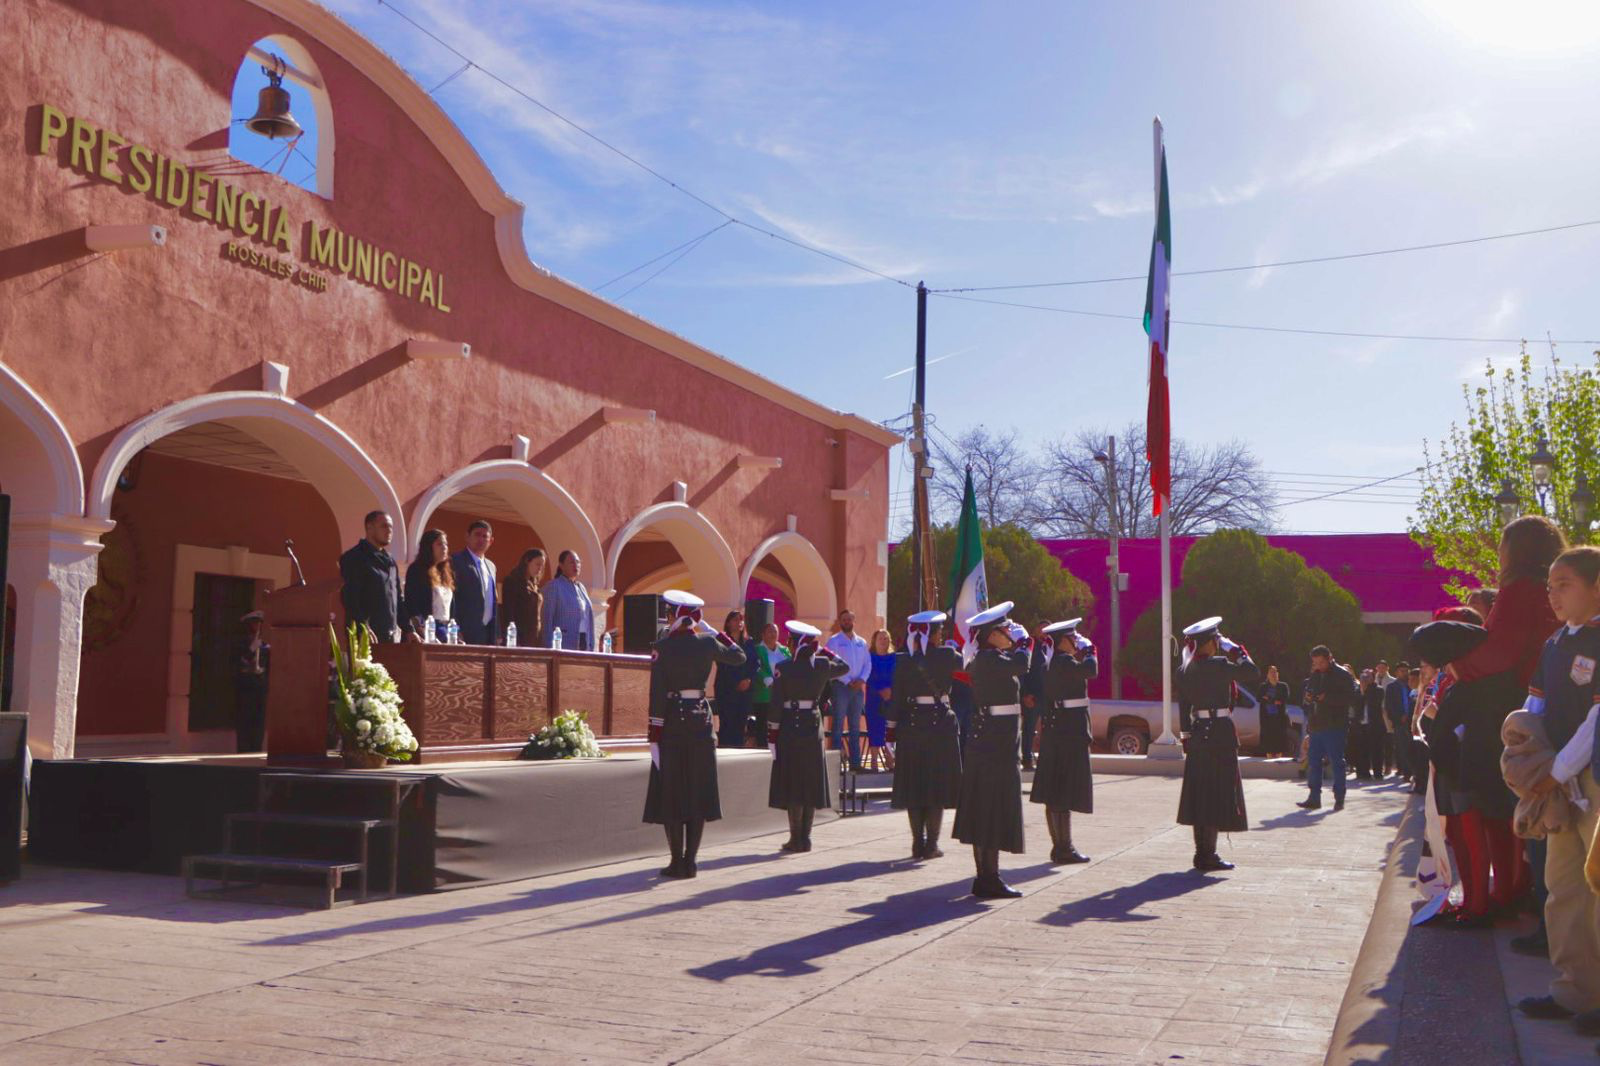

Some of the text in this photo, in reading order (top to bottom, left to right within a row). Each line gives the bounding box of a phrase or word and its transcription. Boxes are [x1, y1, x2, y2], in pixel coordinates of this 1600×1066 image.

[40, 104, 451, 313] PRESIDENCIA MUNICIPAL
[228, 242, 293, 278] ROSALES
